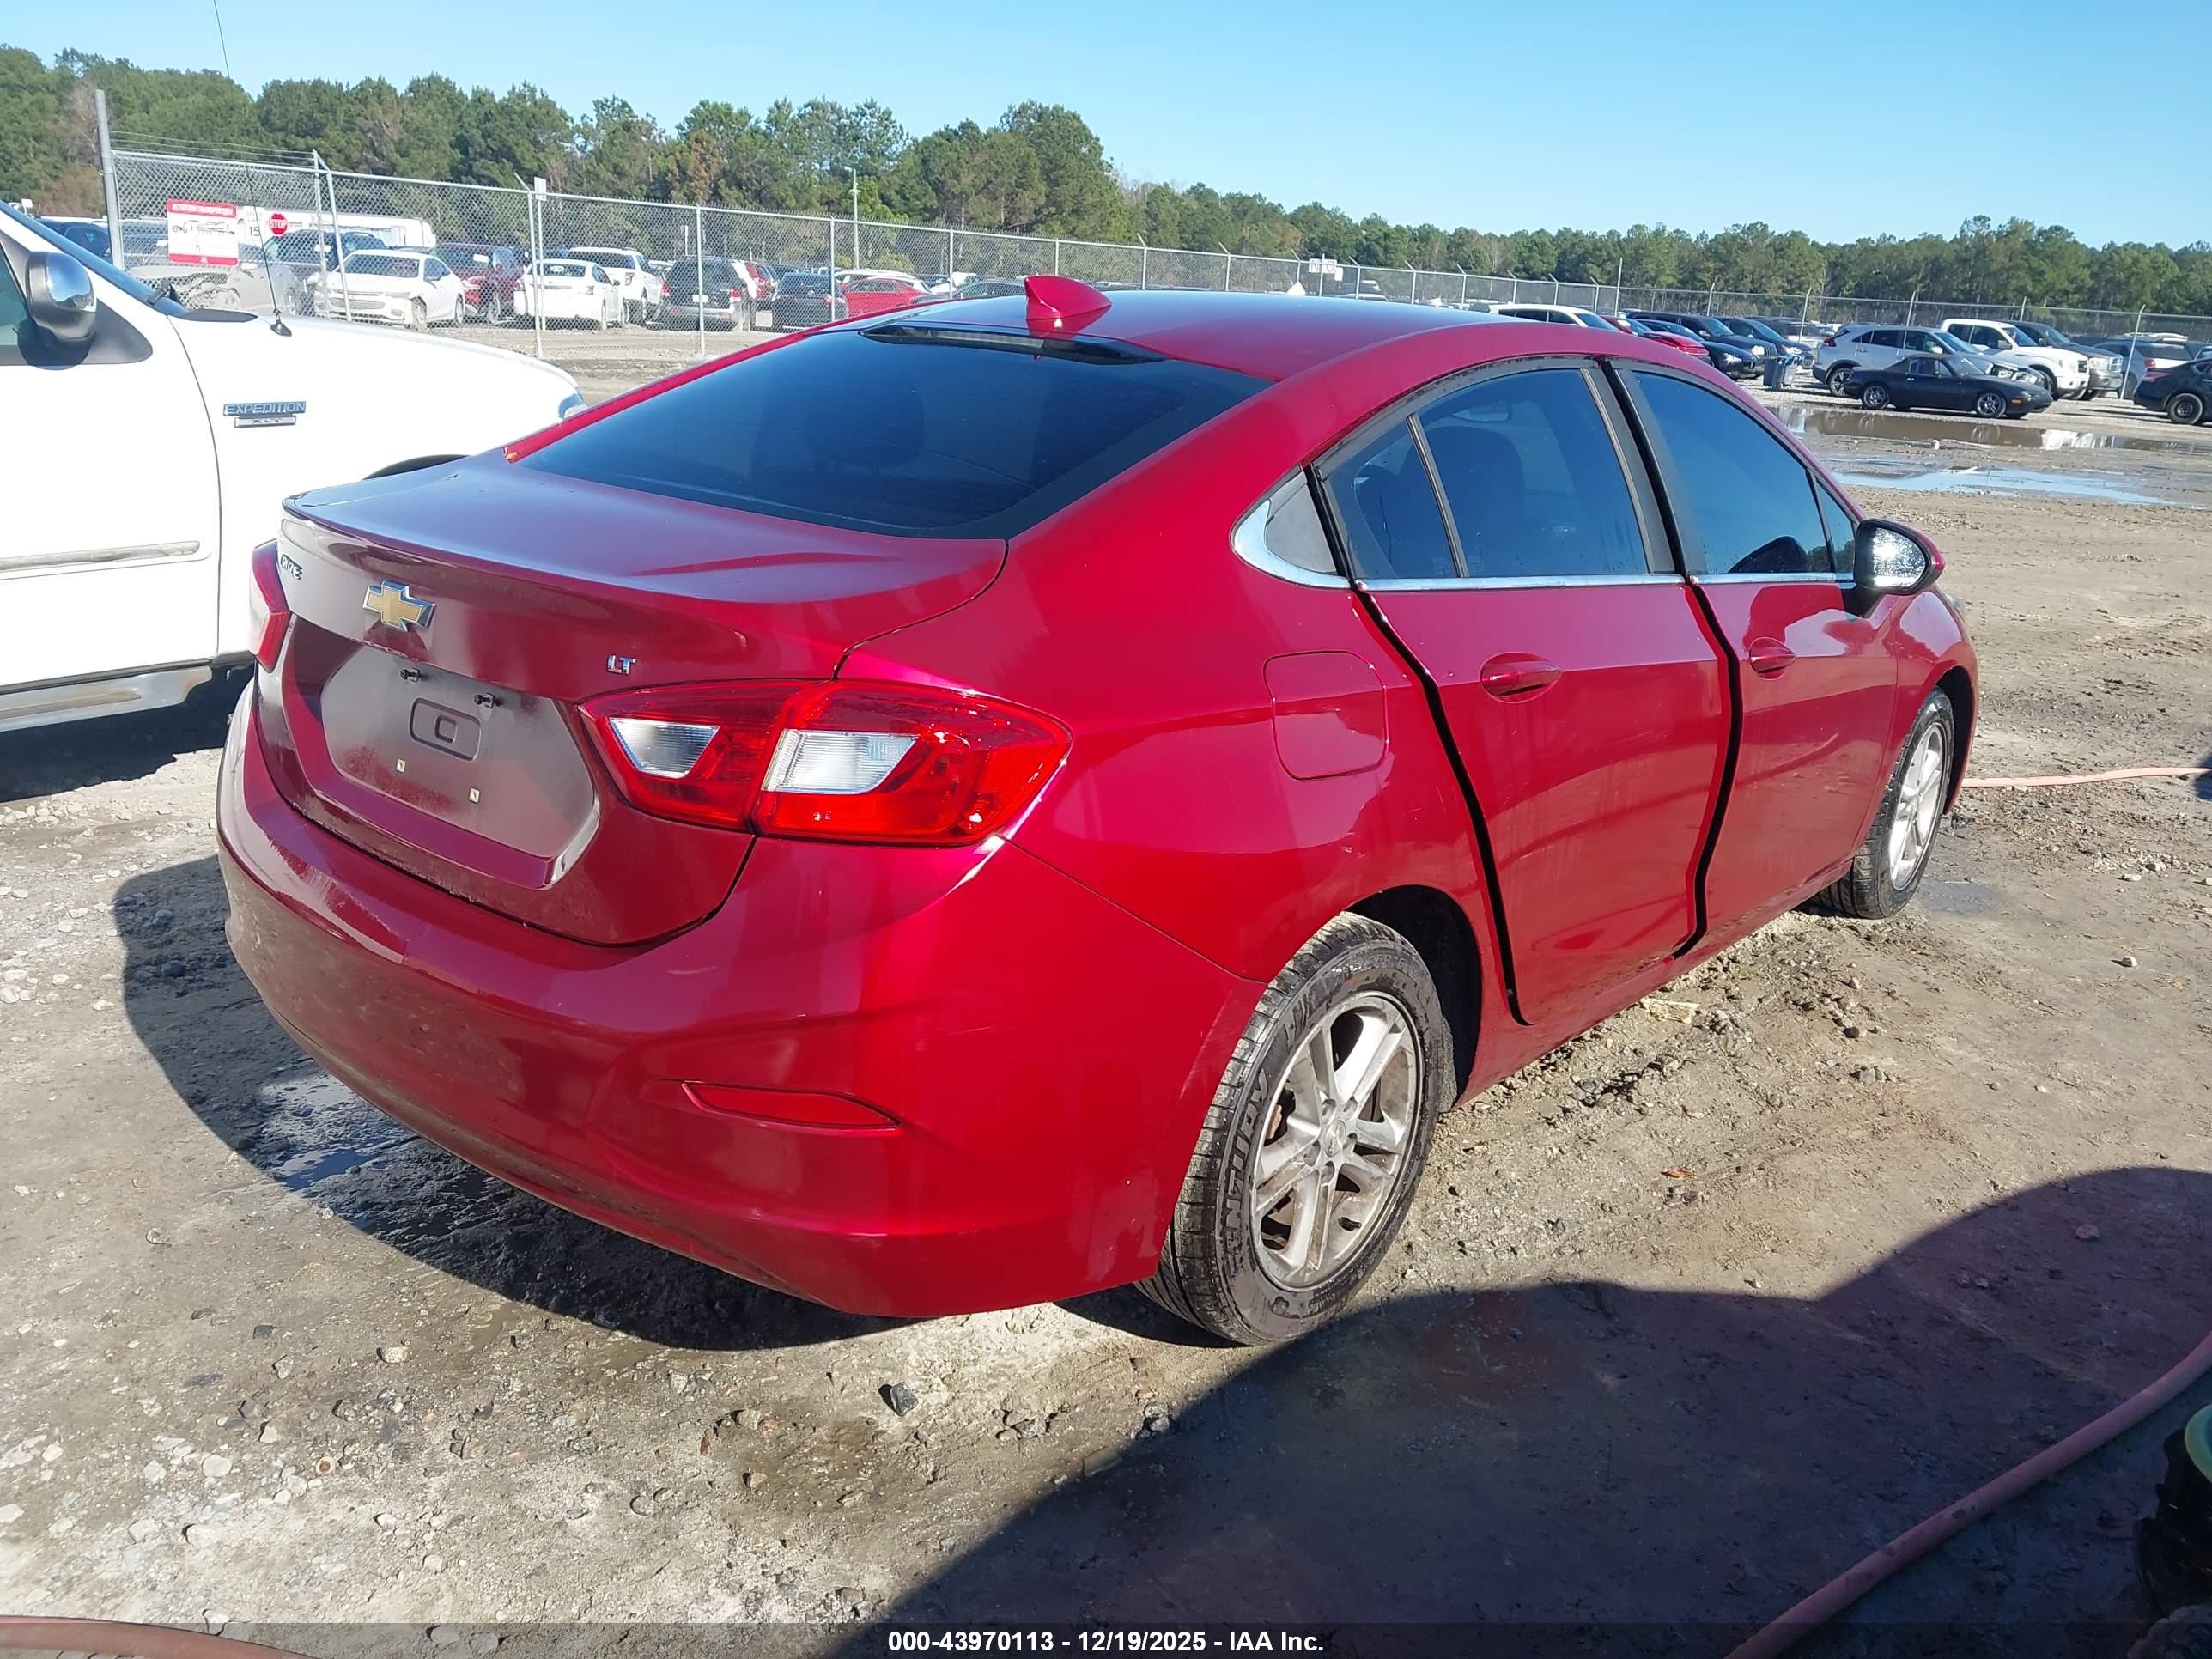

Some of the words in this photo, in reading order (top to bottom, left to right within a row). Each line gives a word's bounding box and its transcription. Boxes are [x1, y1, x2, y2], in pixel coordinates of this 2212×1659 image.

[269, 218, 289, 229] STOP
[249, 226, 260, 236] 15
[225, 402, 305, 414] EXPEDITION
[606, 654, 636, 675] LT
